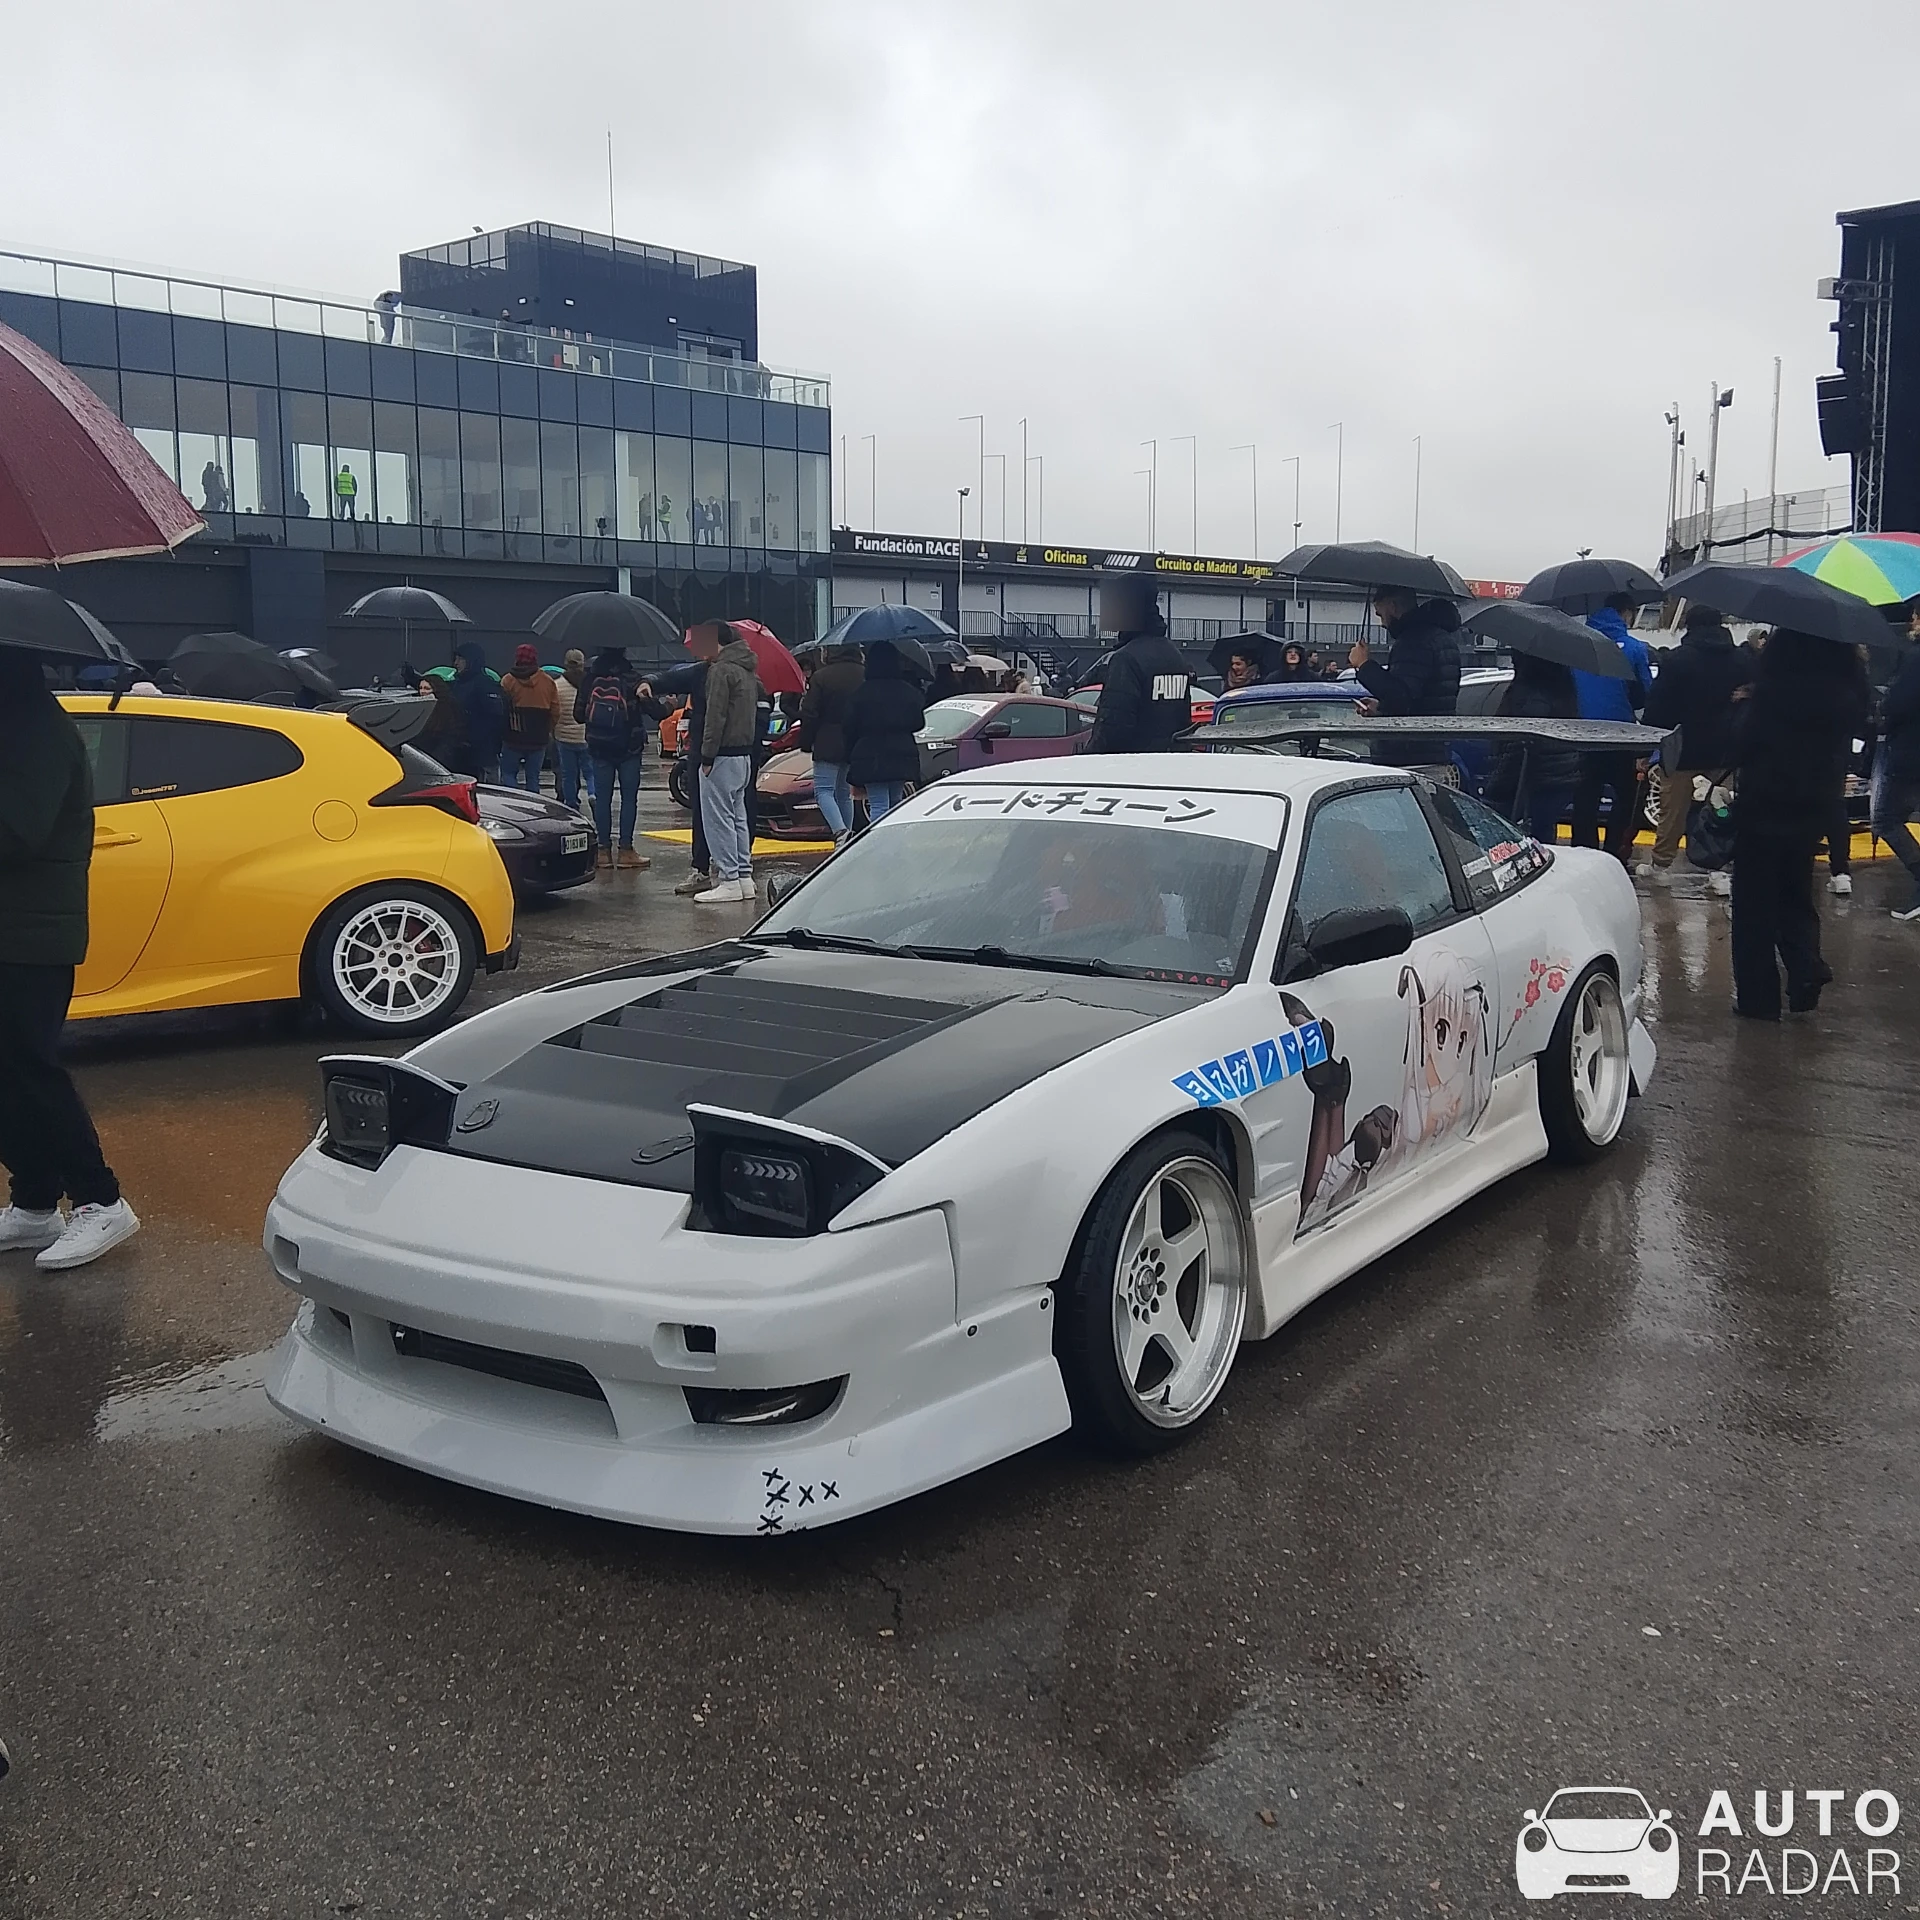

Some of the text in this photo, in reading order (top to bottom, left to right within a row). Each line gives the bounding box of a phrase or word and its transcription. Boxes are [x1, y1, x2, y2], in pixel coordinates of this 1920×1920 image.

[854, 535, 960, 556] Fundación RACE
[1044, 549, 1088, 565] Oficinas
[1155, 557, 1192, 571] Circuito
[1193, 560, 1205, 572] de
[1206, 560, 1238, 574] Madrid
[1504, 584, 1524, 597] FOR
[923, 789, 1216, 824] ハードチューン
